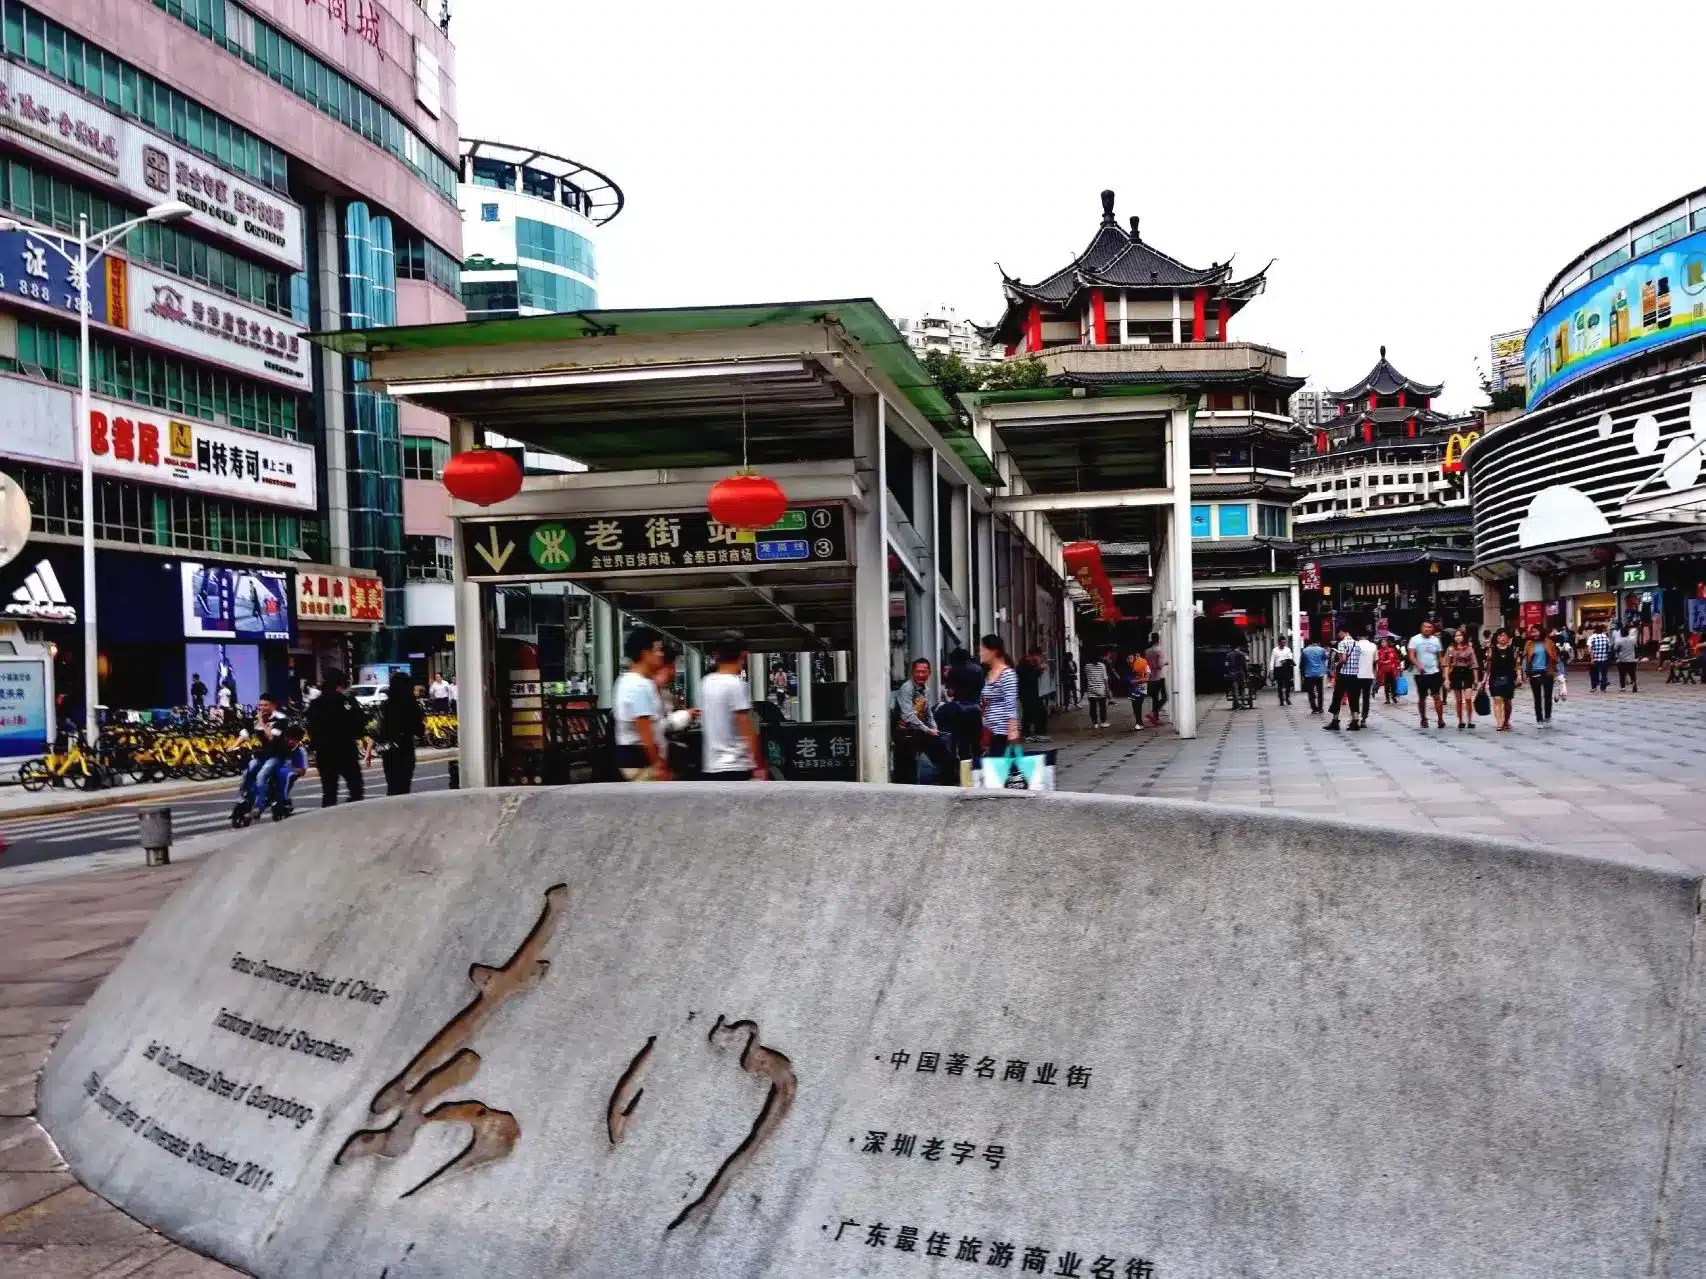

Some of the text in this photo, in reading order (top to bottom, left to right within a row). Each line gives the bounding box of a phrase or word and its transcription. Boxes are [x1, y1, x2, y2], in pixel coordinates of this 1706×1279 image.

[19, 279, 50, 302] 888
[196, 437, 260, 483] 回转寿司
[796, 737, 853, 757] 老街
[889, 1048, 1093, 1090] 中国著名商业街
[861, 1130, 1007, 1171] 深圳老字号
[234, 1161, 274, 1193] 2011
